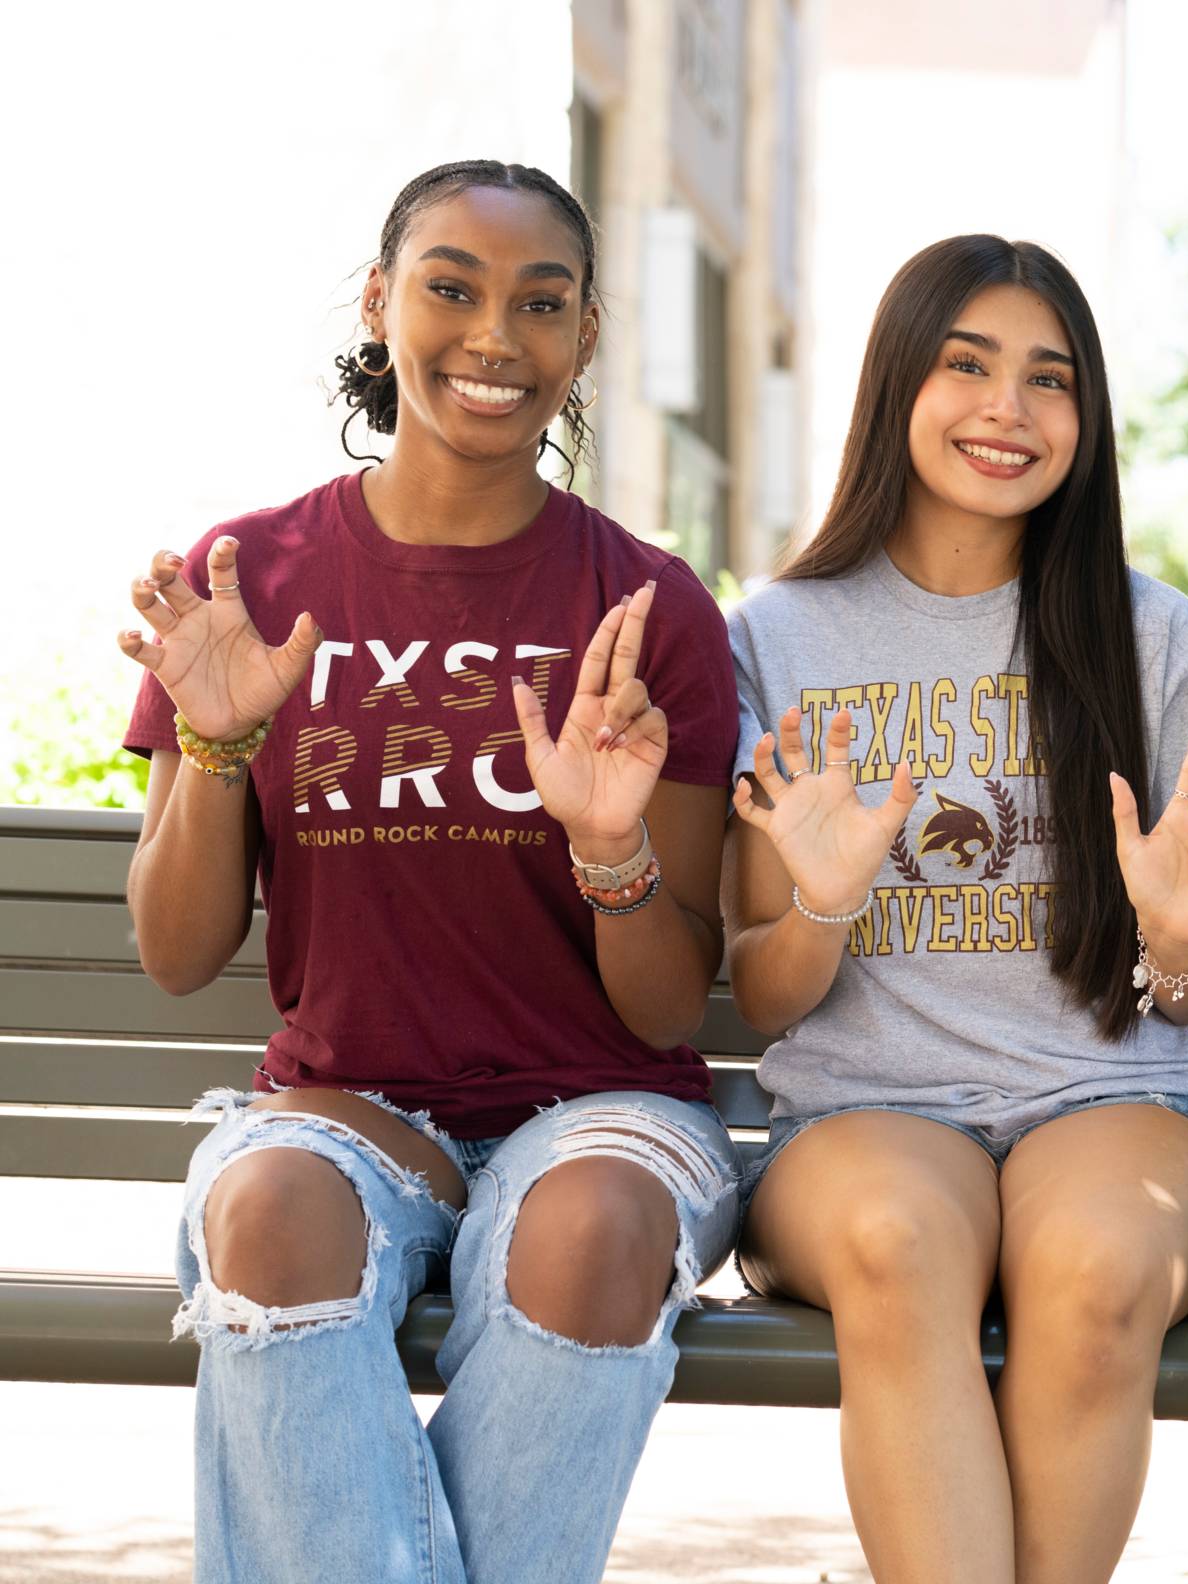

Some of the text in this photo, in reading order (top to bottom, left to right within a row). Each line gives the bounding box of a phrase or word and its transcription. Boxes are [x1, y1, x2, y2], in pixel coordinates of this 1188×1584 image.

[310, 640, 572, 711] TXST
[801, 673, 1049, 785] TEXAS STA
[294, 724, 543, 813] RRC
[296, 825, 547, 847] ROUND ROCK CAMPUS
[1020, 815, 1057, 845] 189
[848, 882, 1064, 957] NIVERSIT
